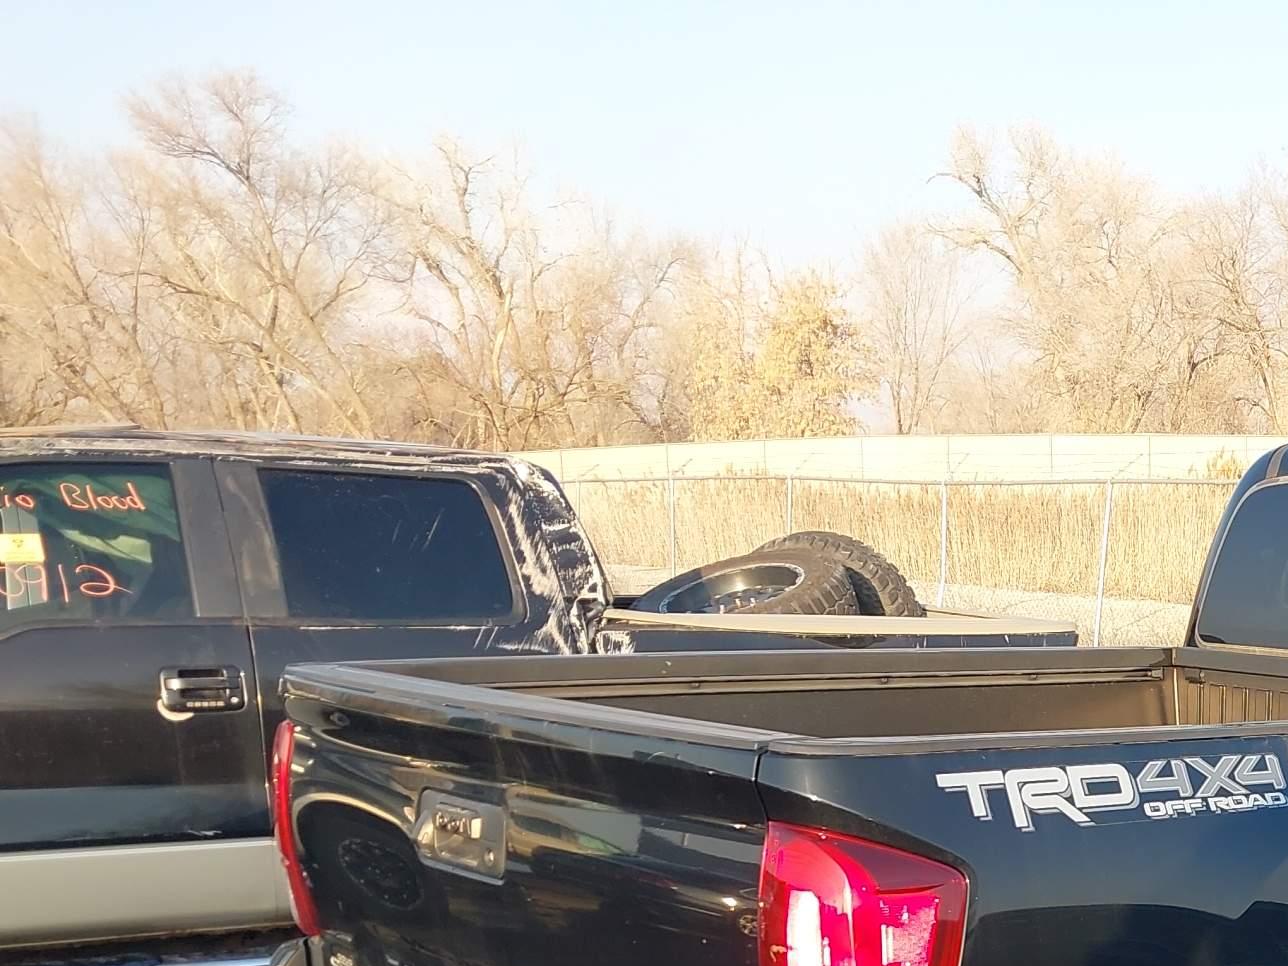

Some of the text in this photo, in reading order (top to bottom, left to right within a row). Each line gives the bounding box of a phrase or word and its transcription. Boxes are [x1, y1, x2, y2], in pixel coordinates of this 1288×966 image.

[59, 481, 146, 511] Blood
[936, 763, 1139, 832] TRD
[1143, 798, 1207, 820] OFF
